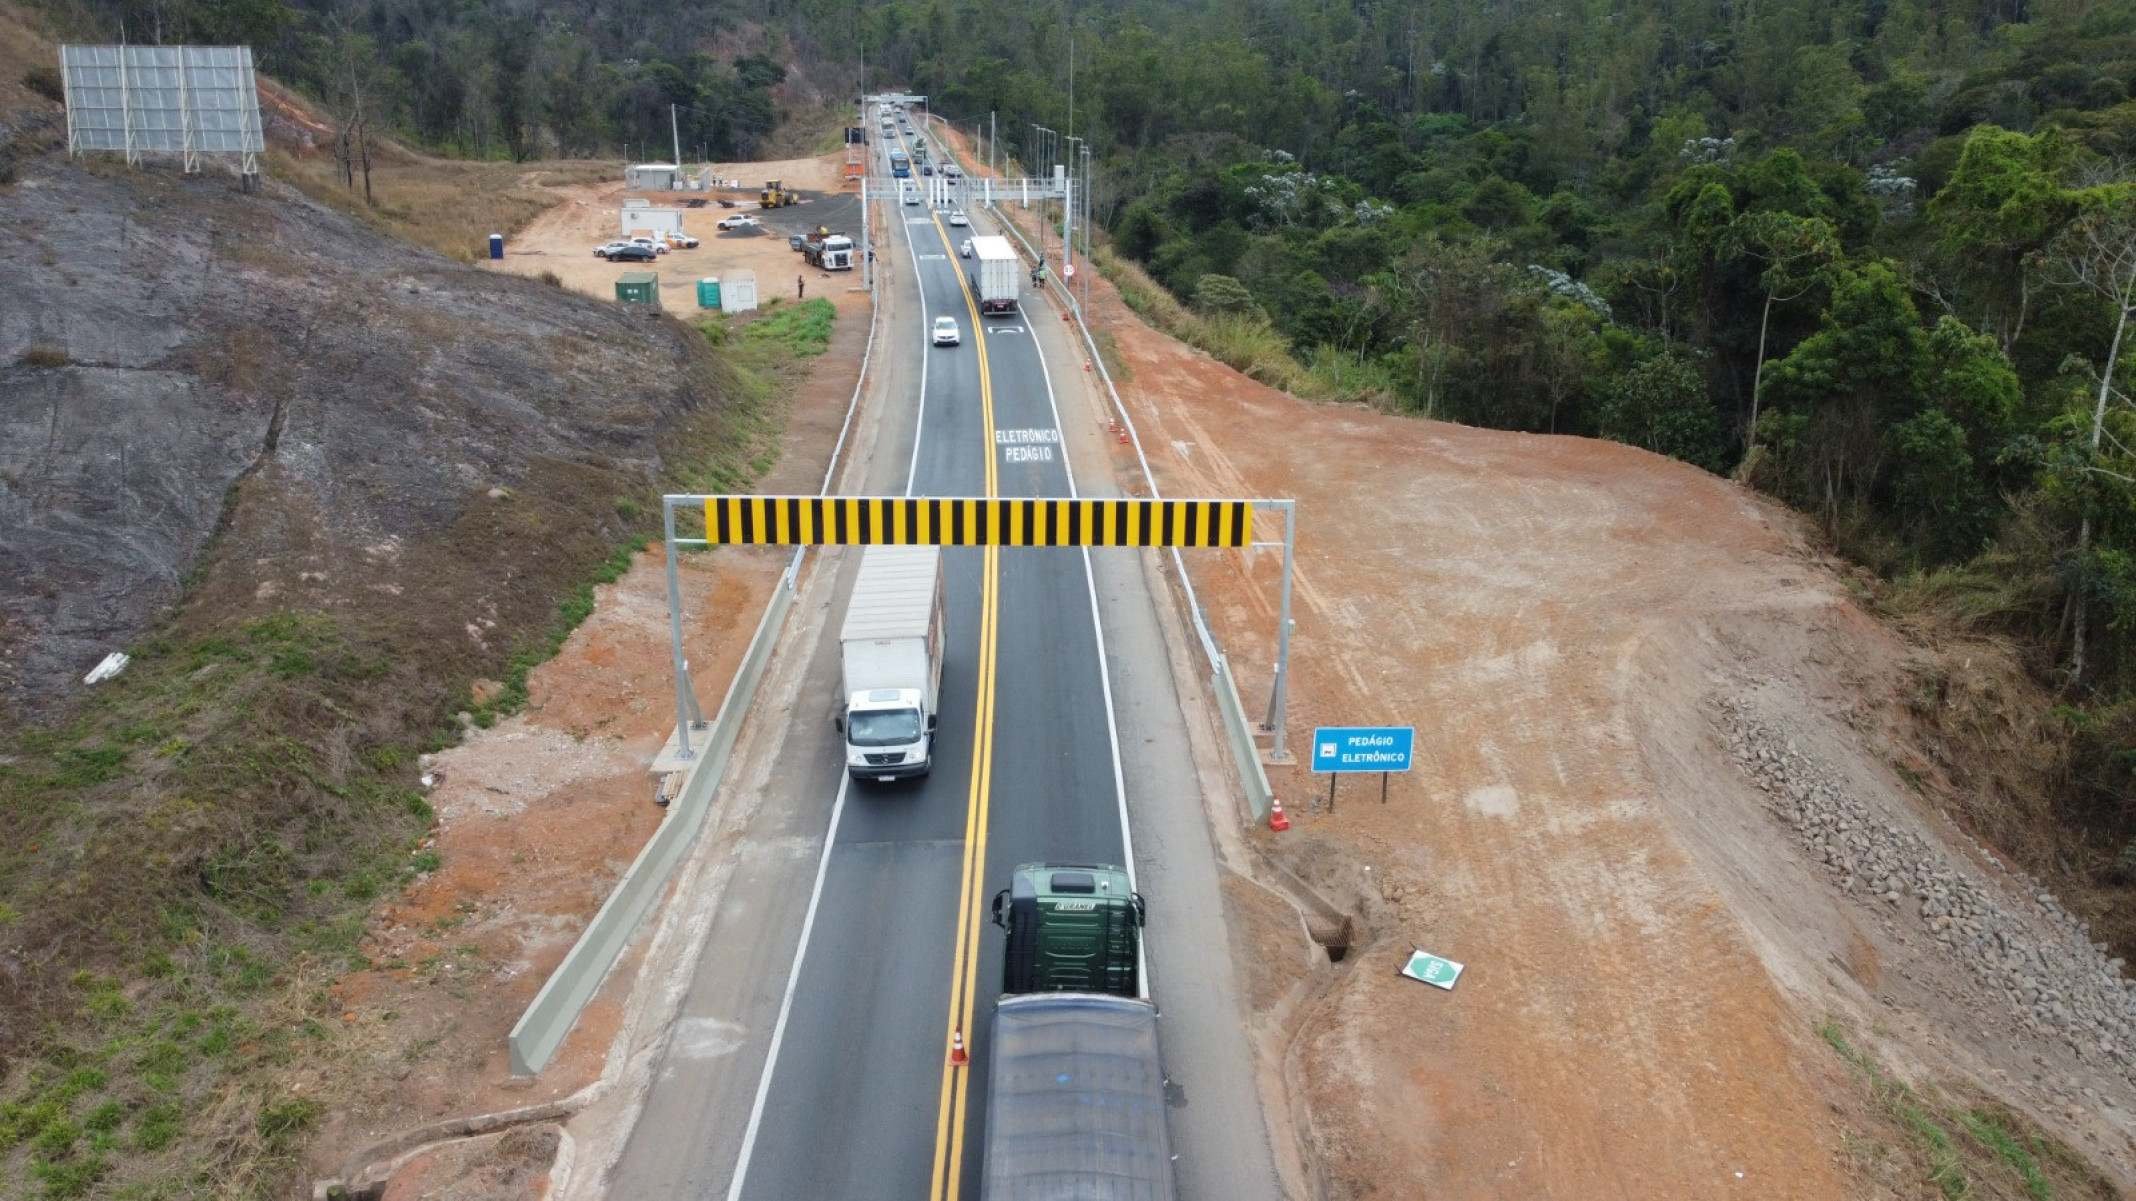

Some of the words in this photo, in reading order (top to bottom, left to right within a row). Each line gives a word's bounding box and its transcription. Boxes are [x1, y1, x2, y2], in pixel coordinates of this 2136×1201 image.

[1005, 445, 1051, 462] PEDÁGIO
[1348, 734, 1393, 746] PEDÁGIO
[1342, 750, 1405, 763] ELETRÔNICO
